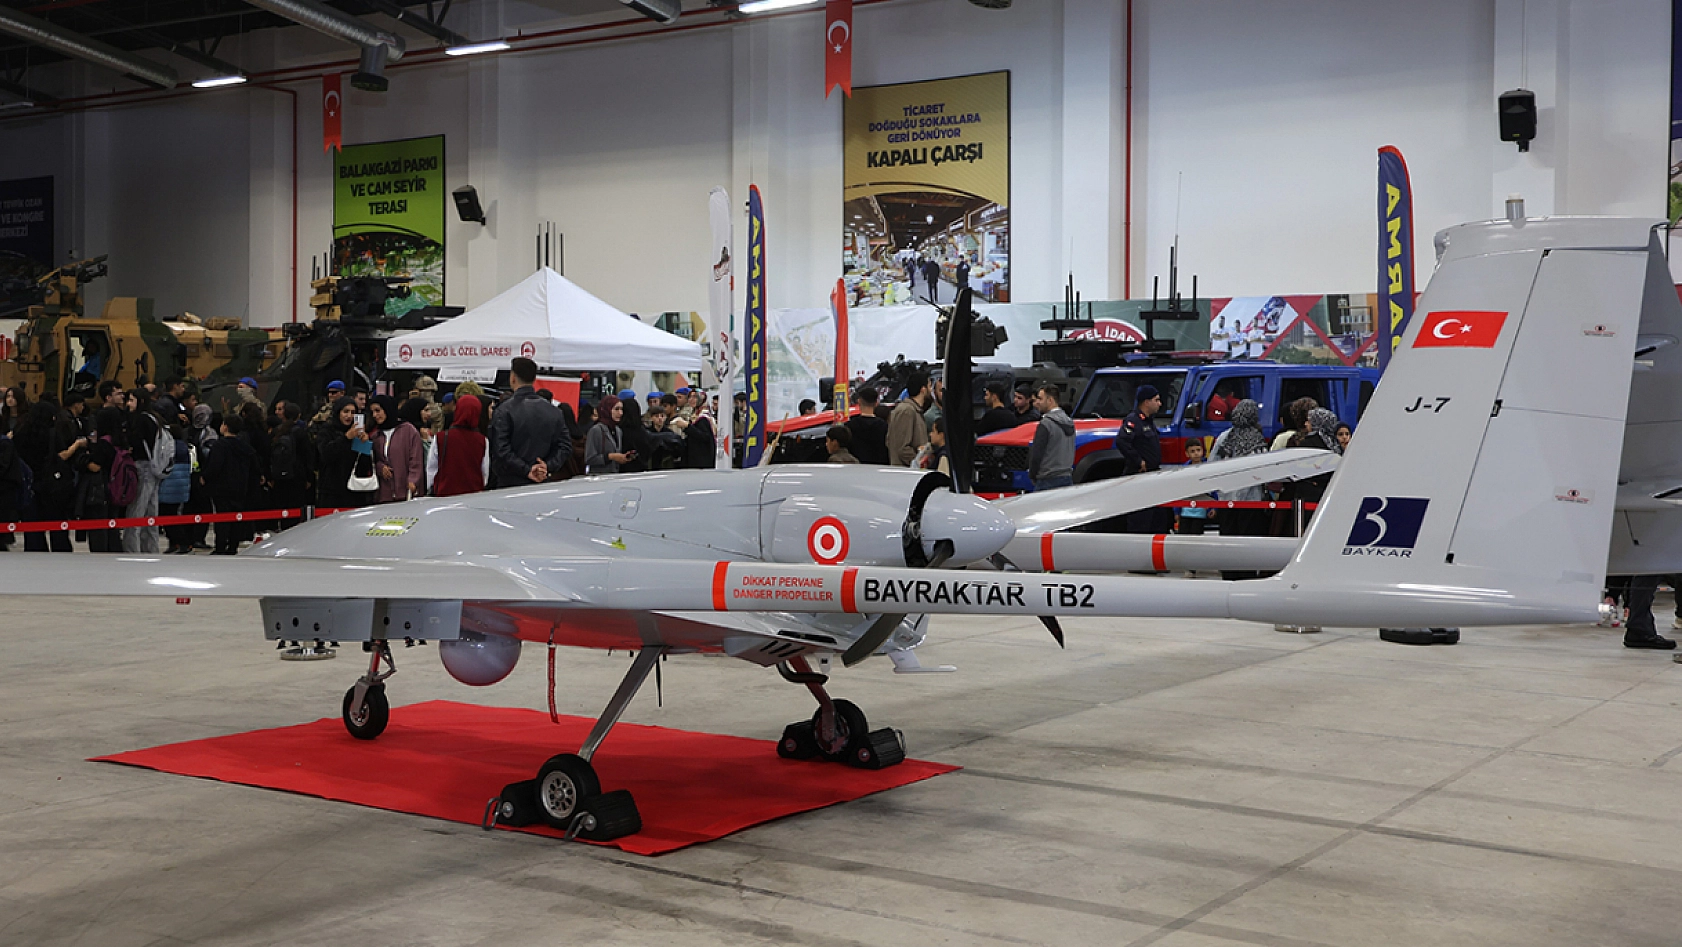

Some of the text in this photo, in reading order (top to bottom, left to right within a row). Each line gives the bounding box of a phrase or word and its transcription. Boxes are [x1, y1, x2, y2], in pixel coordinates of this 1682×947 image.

[903, 103, 945, 117] TİCARET
[868, 112, 981, 133] DOĞDUĞU SOKAKLARA
[887, 127, 961, 144] GERİ DÖNÜYOR
[867, 142, 982, 168] KAPALI ÇARŞI
[339, 155, 438, 179] BALAKGAZİ PARKI
[350, 175, 427, 197] VE CAM SEYİR
[368, 199, 407, 215] TERASI
[1, 210, 45, 224] VE KONGRE
[421, 345, 448, 358] ELAZIĞ
[458, 344, 478, 356] ÖZEL
[1404, 396, 1451, 413] J-7
[1341, 547, 1413, 559] BAYKAR
[742, 574, 823, 588] DİKKAT PERVANE
[733, 588, 834, 601] DANGER PROPELLER
[864, 579, 1095, 608] BAYRAKTAR TB2
